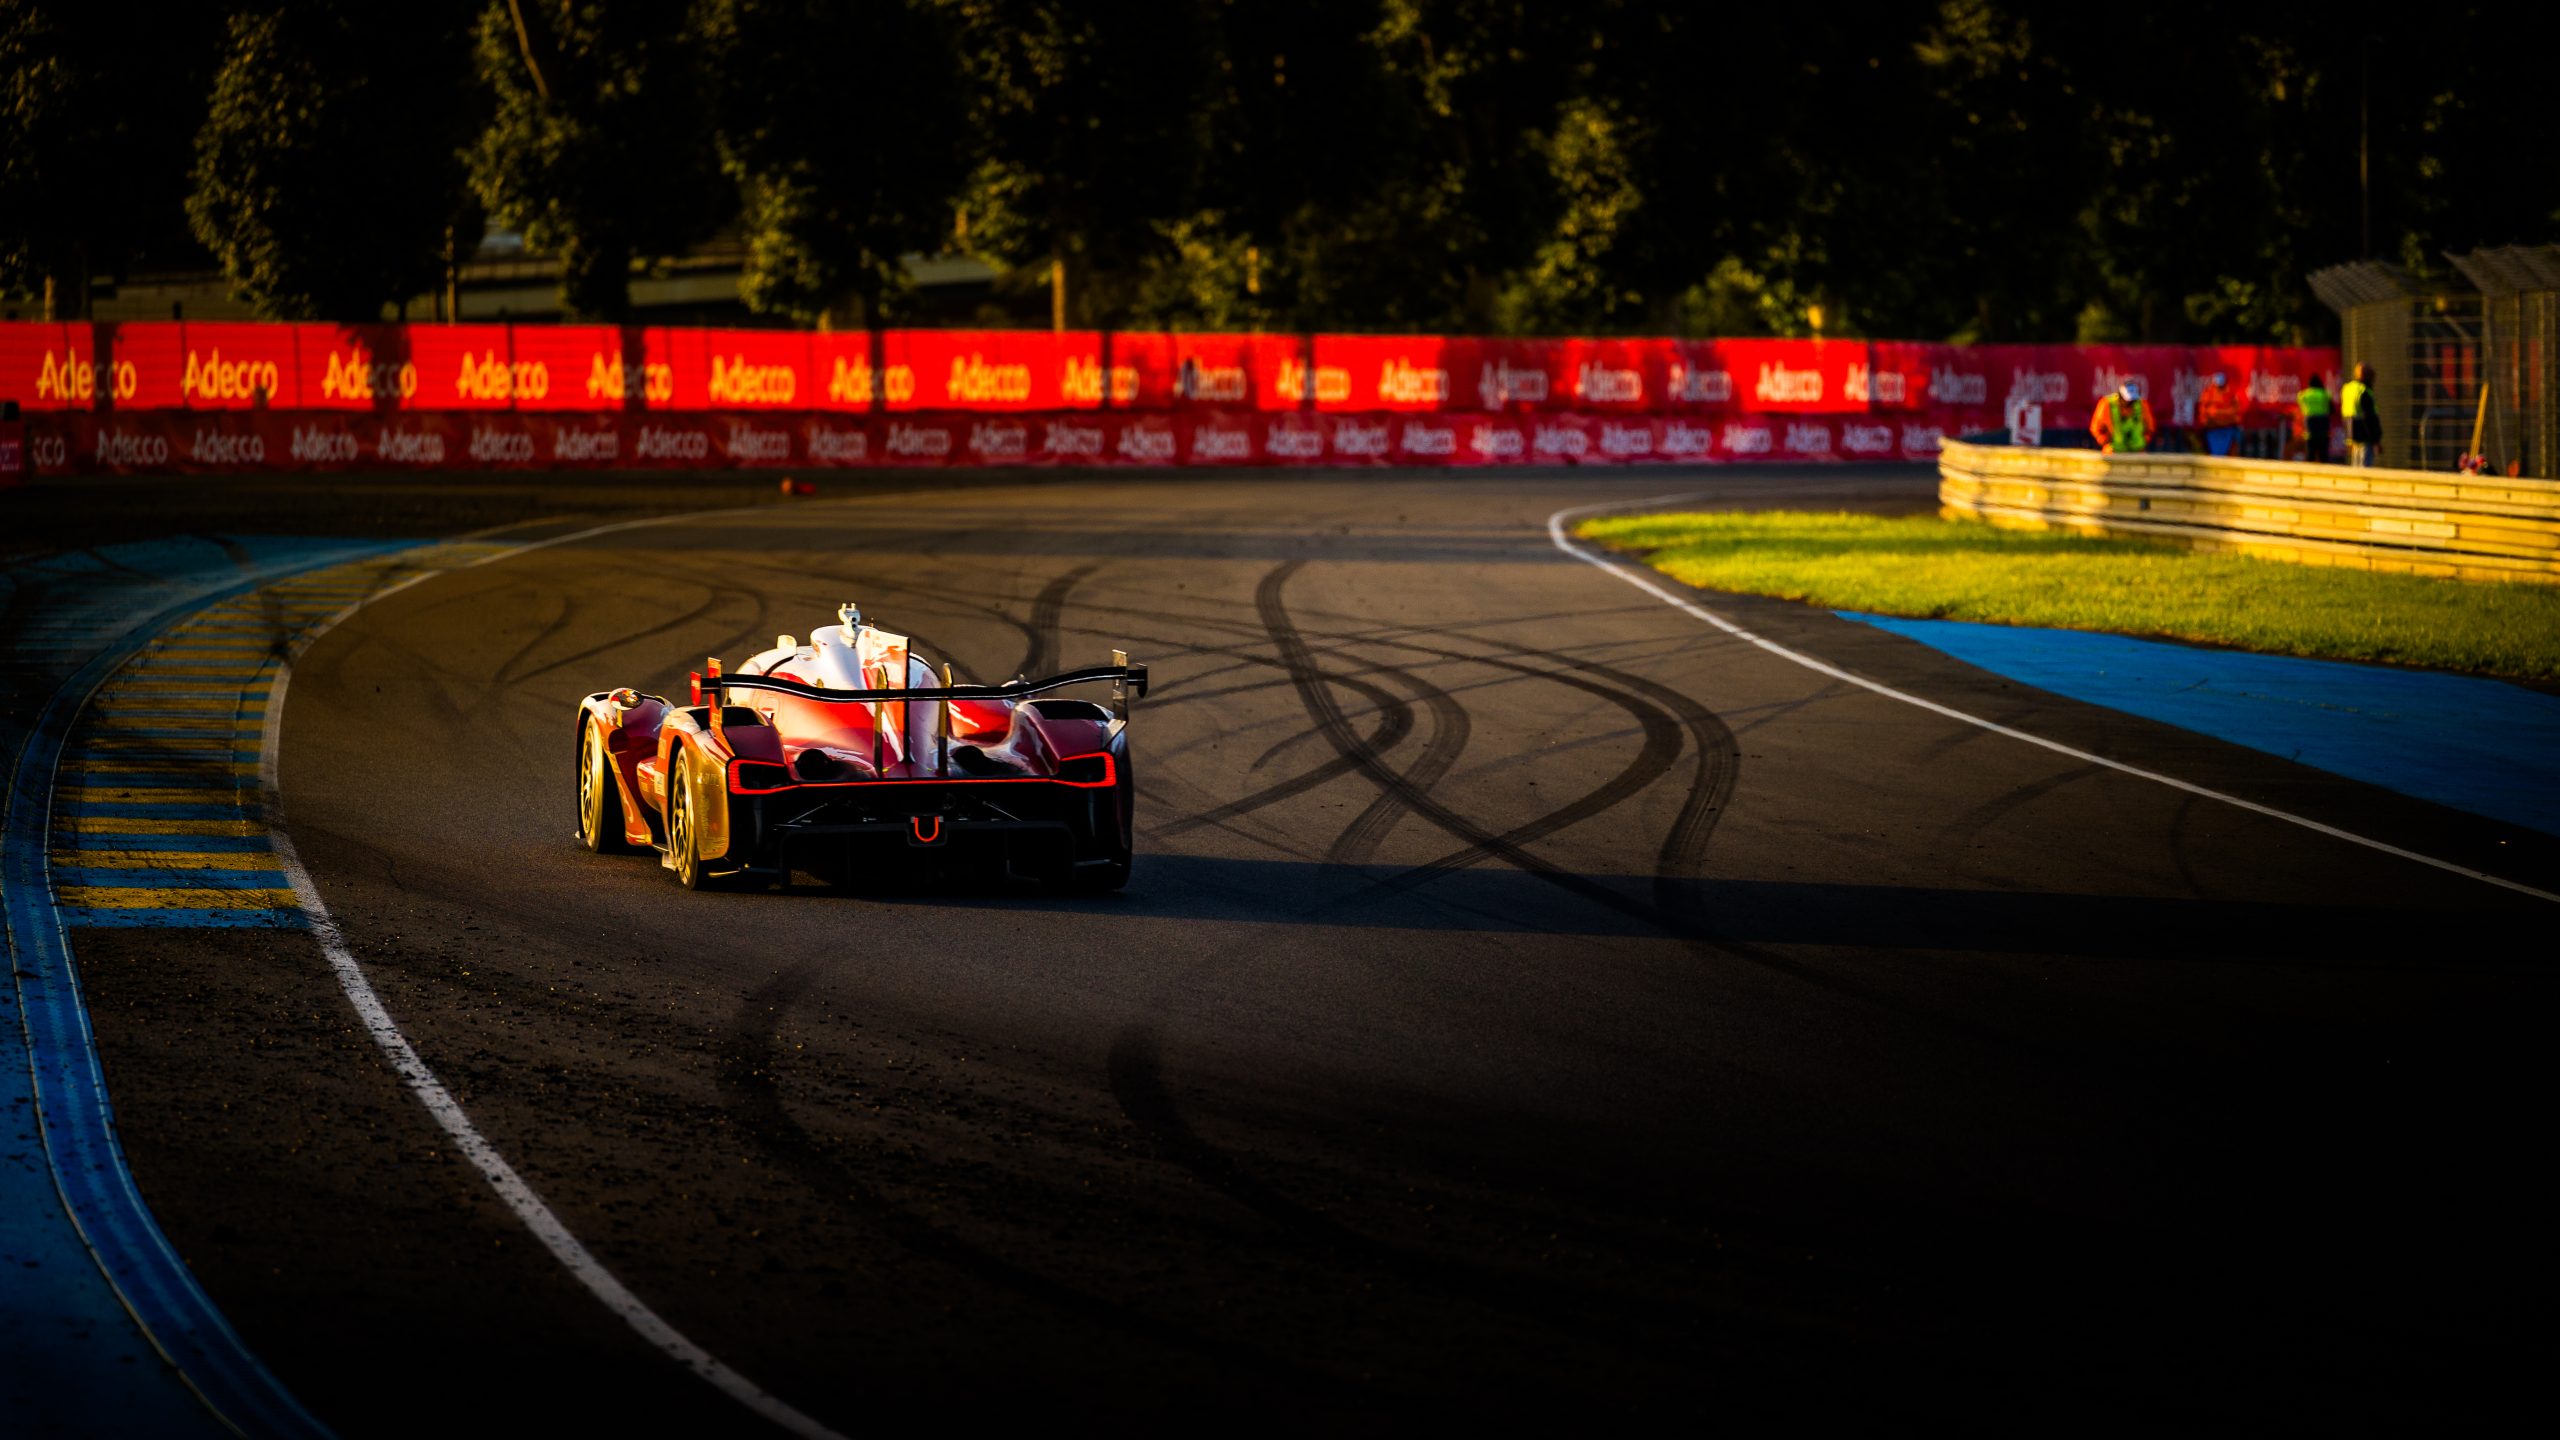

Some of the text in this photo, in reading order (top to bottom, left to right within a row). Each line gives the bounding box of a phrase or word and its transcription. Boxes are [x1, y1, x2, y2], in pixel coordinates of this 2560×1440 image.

[36, 346, 137, 400] Adecco
[181, 347, 278, 399] Adecco
[322, 348, 417, 399] Adecco
[456, 348, 549, 400] Adecco
[587, 349, 673, 402] Adecco
[709, 354, 796, 403] Adecco
[829, 354, 914, 402] Adecco
[947, 353, 1031, 402] Adecco
[1062, 354, 1140, 402] Adecco
[1174, 357, 1246, 401] Adecco
[1276, 358, 1350, 402] Adecco
[1379, 357, 1449, 402] Adecco
[1576, 361, 1642, 401] Adecco
[1668, 361, 1732, 402] Adecco
[1756, 360, 1824, 402] Adecco
[97, 428, 168, 465] Adecco
[192, 429, 264, 463] Adecco
[290, 424, 358, 462] Adecco
[378, 426, 444, 463] Adecco
[470, 426, 534, 461] Adecco
[554, 425, 619, 460] Adecco
[637, 425, 708, 460] Adecco
[727, 424, 790, 458] Adecco
[808, 422, 866, 459] Adecco
[886, 423, 951, 455] Adecco
